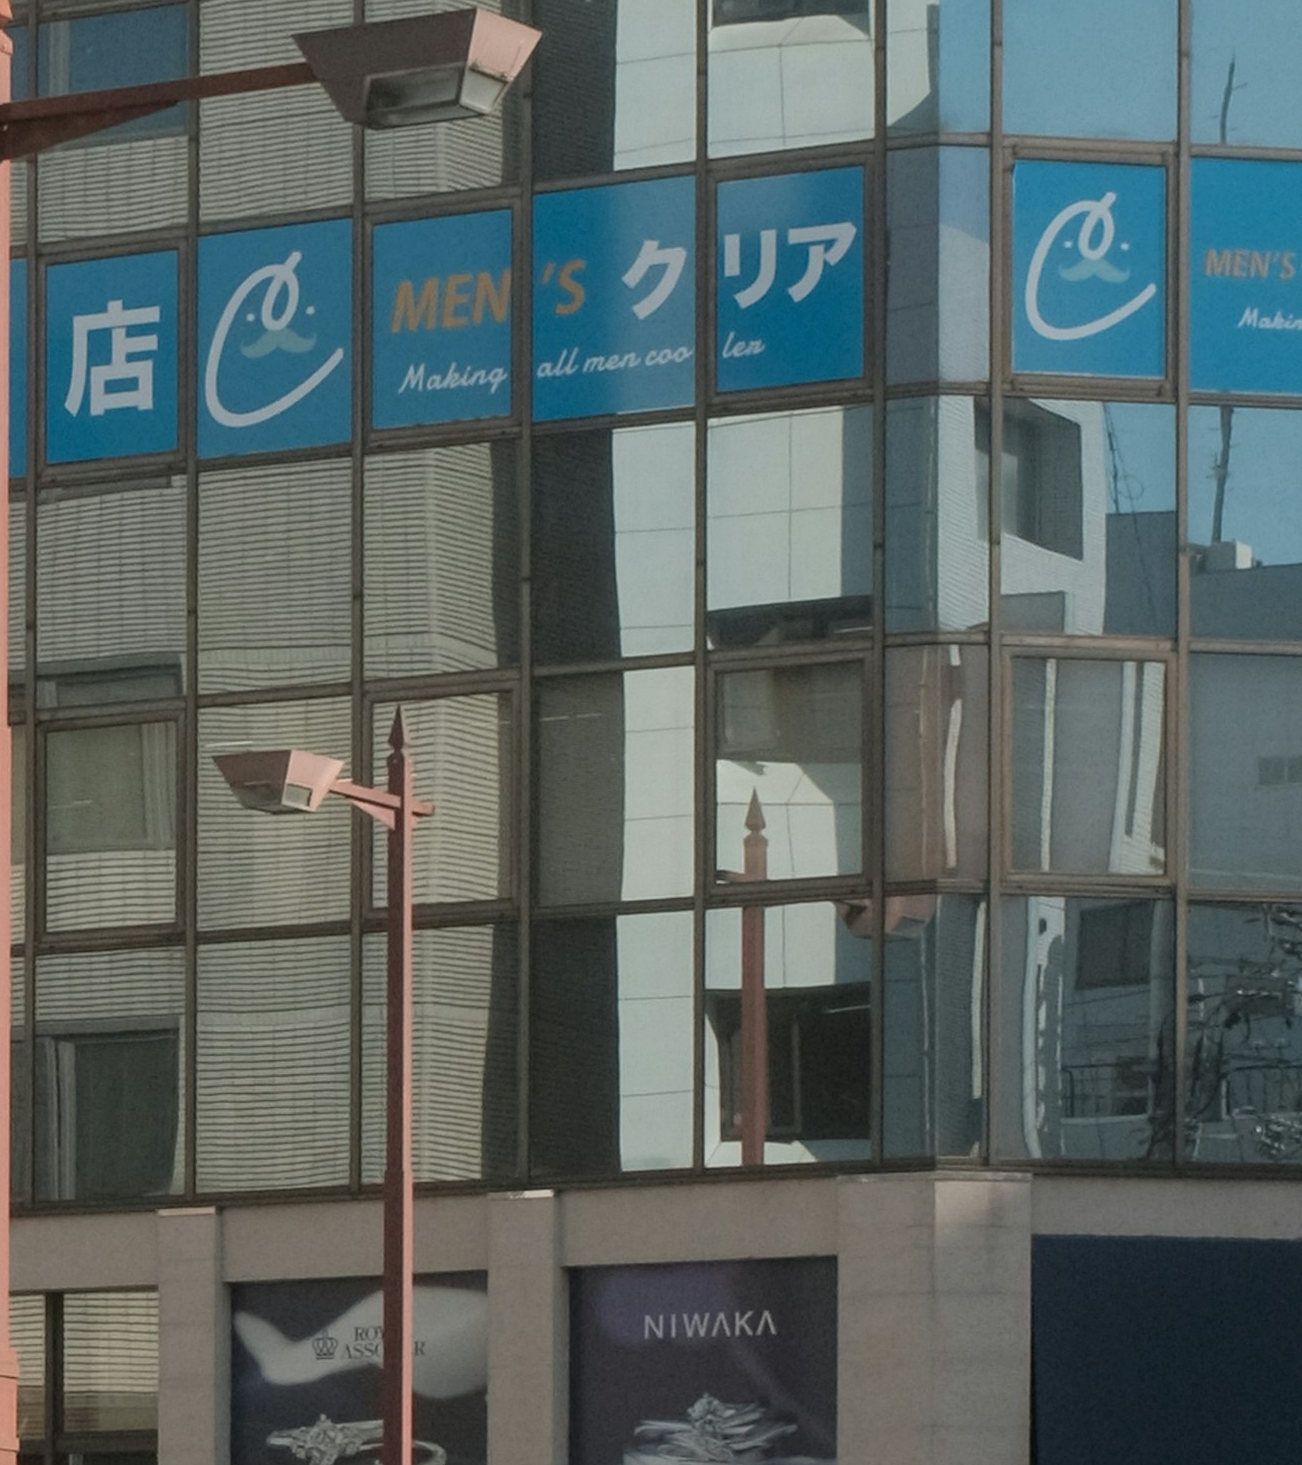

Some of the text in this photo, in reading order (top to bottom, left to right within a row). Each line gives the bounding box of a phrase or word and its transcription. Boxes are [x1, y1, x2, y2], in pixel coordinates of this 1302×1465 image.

[621, 221, 858, 321] クリア
[1237, 307, 1302, 331] Makin
[398, 364, 508, 395] Making
[537, 349, 578, 379] all
[583, 352, 640, 374] men
[644, 1309, 777, 1341] NIWAKA
